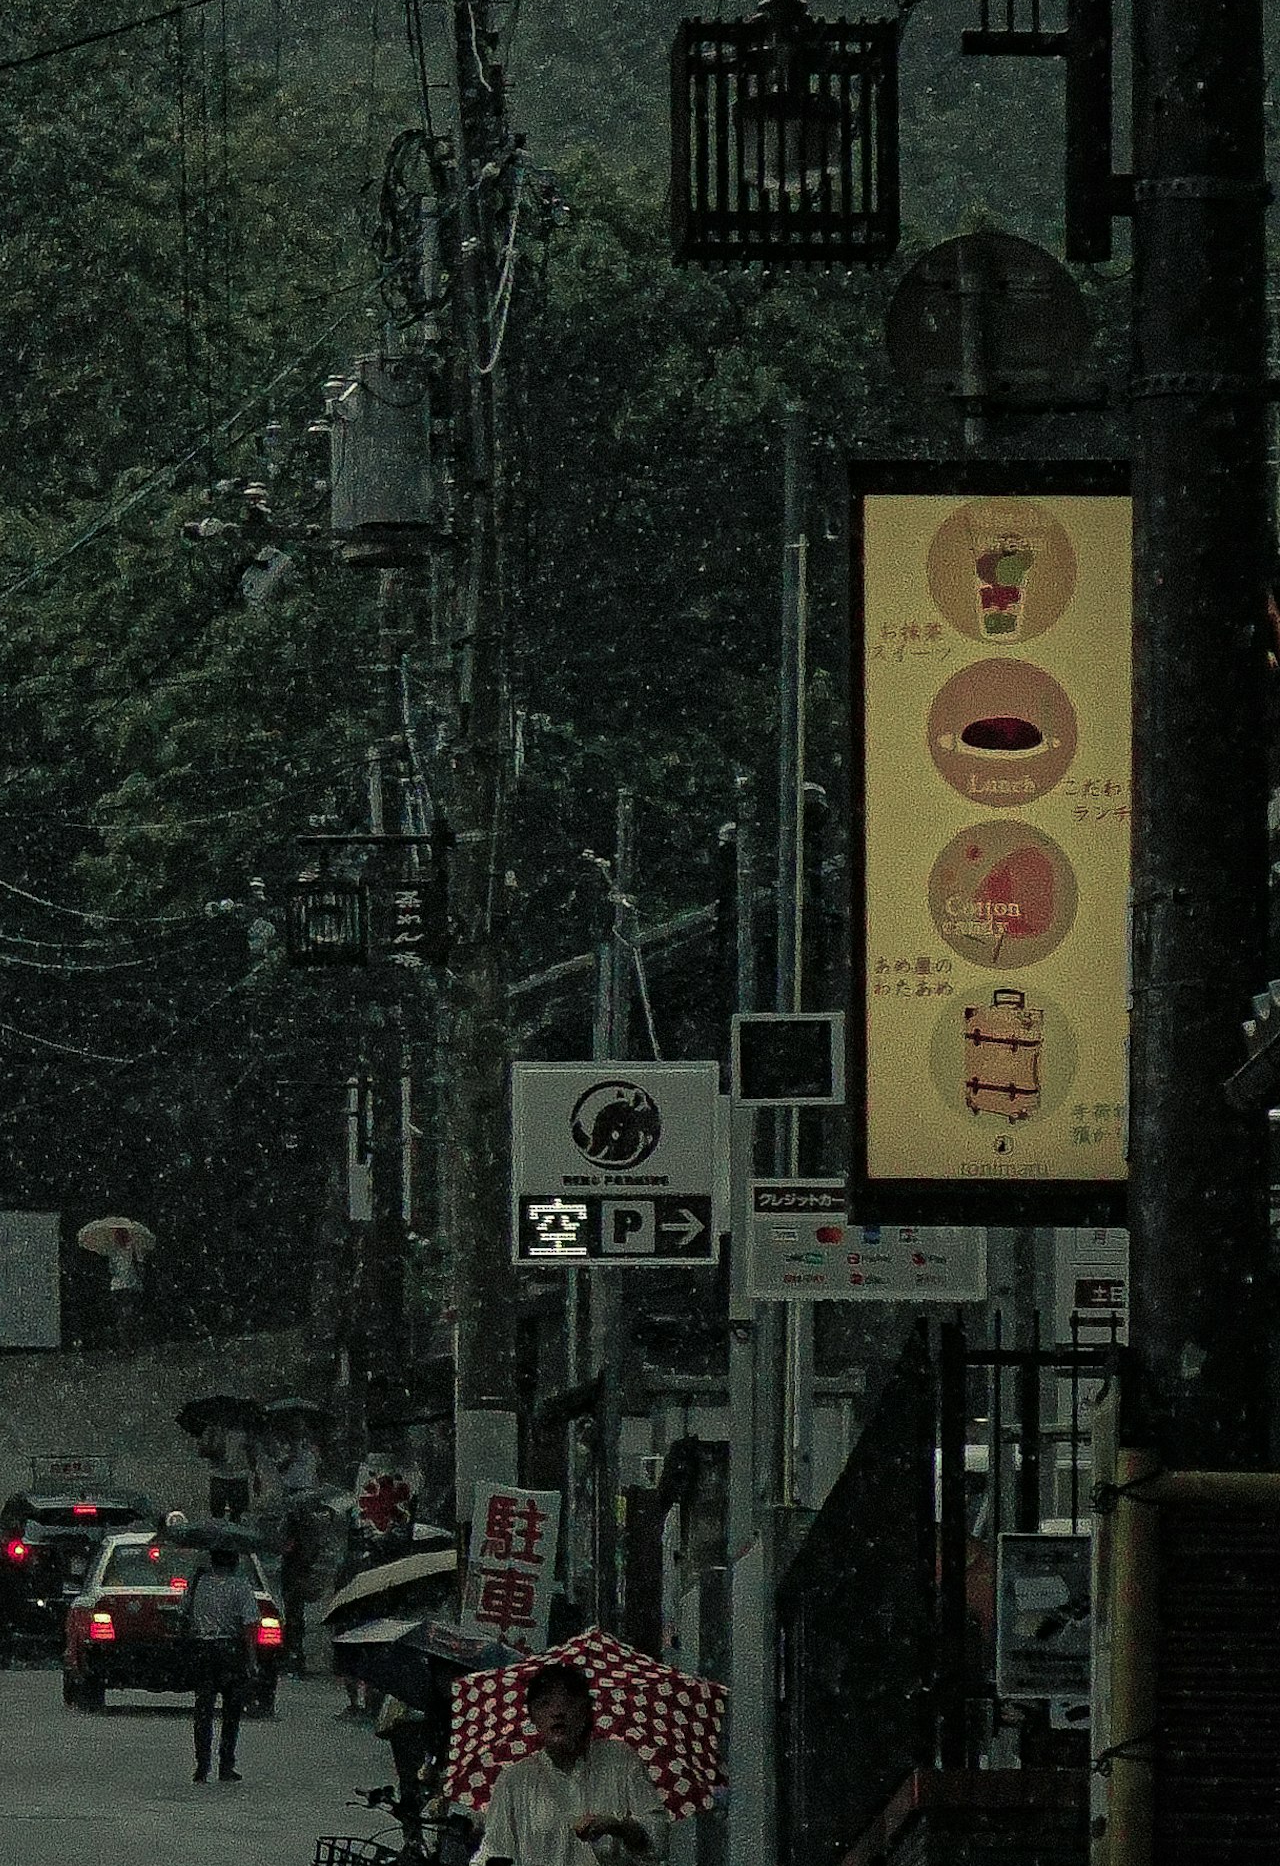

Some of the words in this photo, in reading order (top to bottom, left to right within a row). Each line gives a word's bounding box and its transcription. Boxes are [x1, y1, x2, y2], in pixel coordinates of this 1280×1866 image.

[528, 1198, 587, 1256] 空
[613, 1210, 642, 1244] P
[476, 1494, 548, 1655] 駐車
